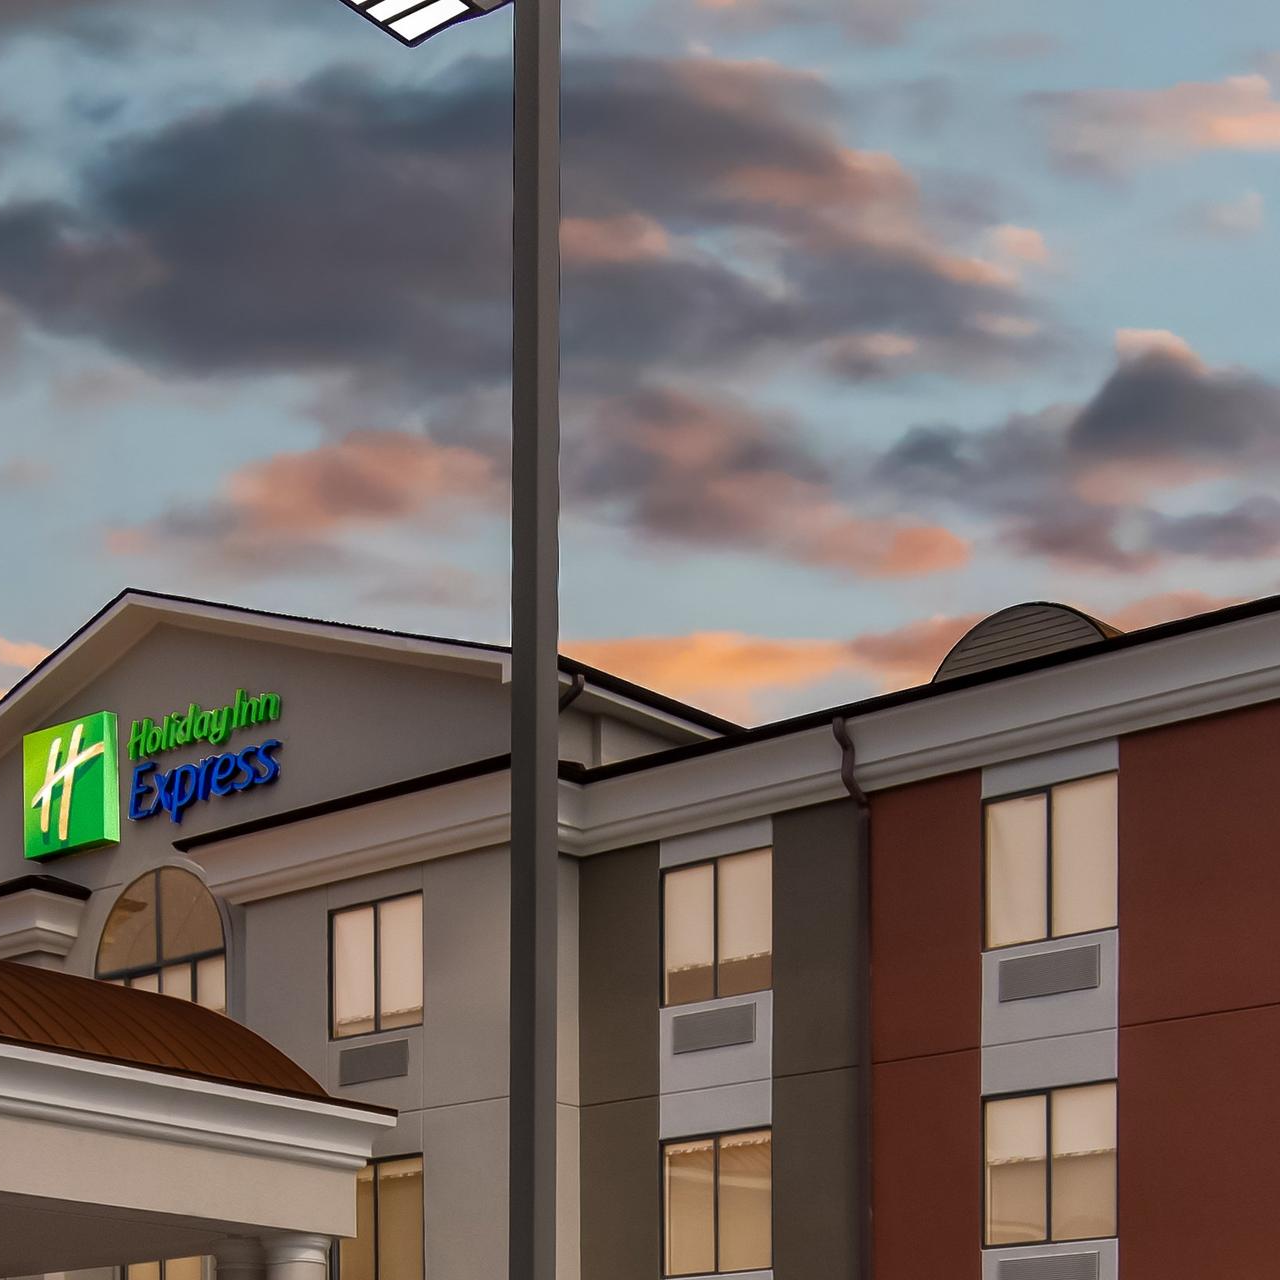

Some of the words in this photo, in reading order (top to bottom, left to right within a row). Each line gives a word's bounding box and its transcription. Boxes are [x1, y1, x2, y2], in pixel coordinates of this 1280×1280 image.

[126, 703, 233, 760] Holiday
[232, 688, 282, 729] Inn
[128, 739, 283, 825] Express
